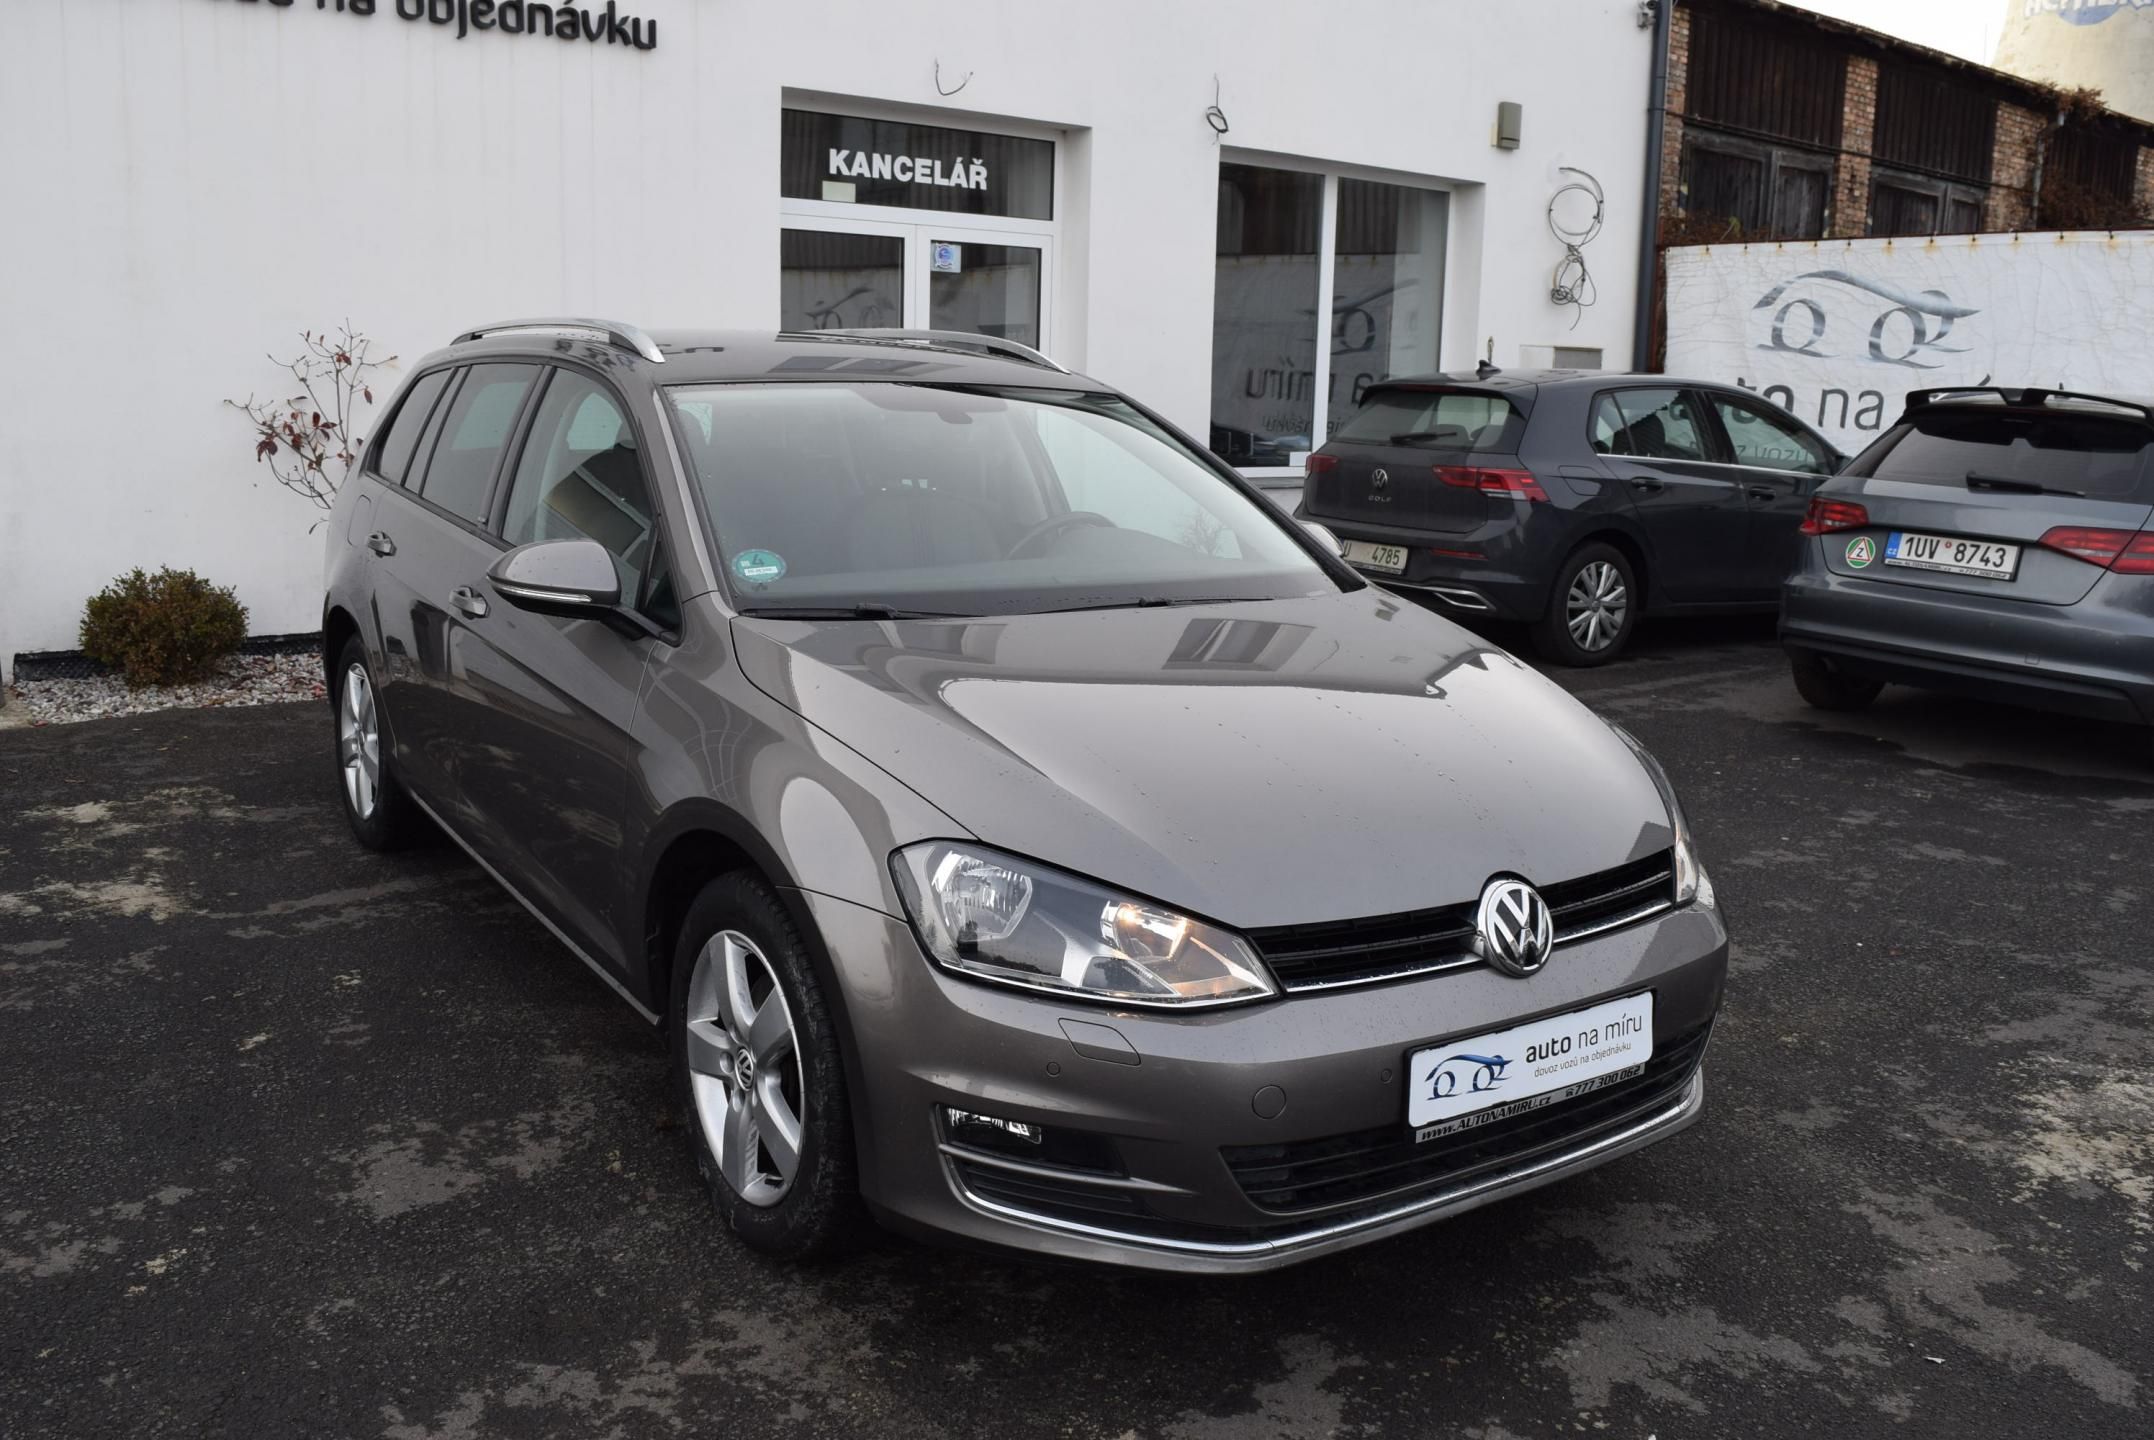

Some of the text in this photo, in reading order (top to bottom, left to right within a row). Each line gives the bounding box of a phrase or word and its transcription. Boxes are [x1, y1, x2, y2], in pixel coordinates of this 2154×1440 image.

[395, 0, 657, 50] objednávku
[829, 148, 988, 190] KANCELÁŘ
[1817, 388, 1885, 430] na
[1372, 545, 1401, 565] 4785
[1886, 548, 1897, 556] CZ
[1905, 536, 1940, 560] 1UV
[1953, 542, 2007, 568] 8743
[1482, 880, 1553, 976] VW
[1525, 1012, 1642, 1064] auto na míru
[1534, 1063, 1558, 1078] dovoz
[1580, 1054, 1590, 1065] na
[1591, 1042, 1632, 1061] objednávku
[1574, 1079, 1595, 1096] 777
[1596, 1073, 1618, 1089] 300
[1619, 1065, 1641, 1081] 062
